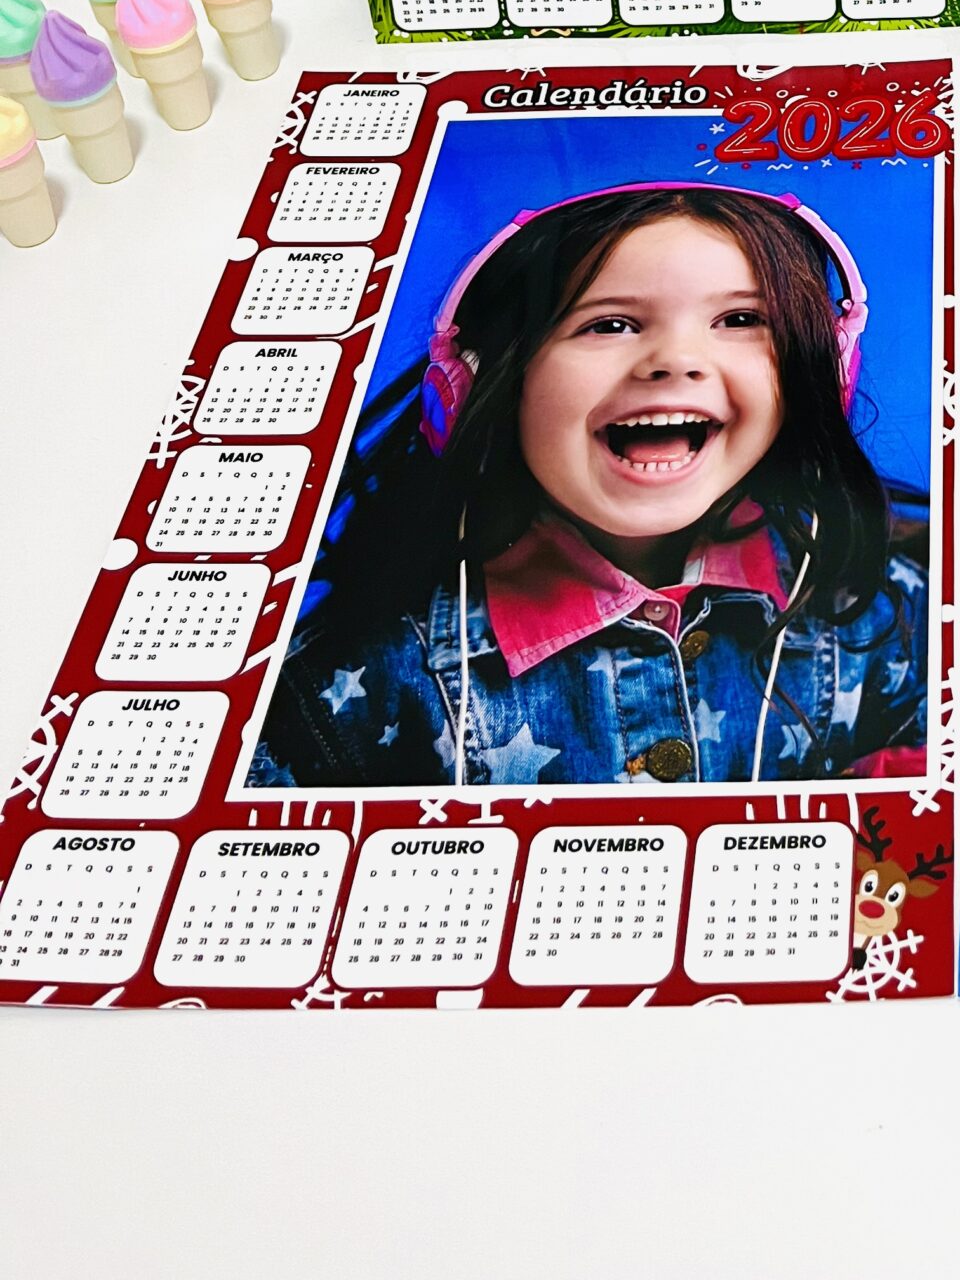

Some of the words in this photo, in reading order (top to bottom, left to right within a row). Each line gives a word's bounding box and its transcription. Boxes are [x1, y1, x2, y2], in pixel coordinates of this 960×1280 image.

[342, 89, 400, 98] JANEIRO
[483, 78, 709, 110] Calendário
[715, 91, 951, 162] 2026
[305, 166, 381, 176] FEVEREIRO
[287, 252, 344, 265] MARÇO
[254, 347, 298, 358] ABRIL
[218, 451, 264, 463] MAIO
[167, 570, 228, 582] JUNHO
[121, 698, 181, 712] JULHO
[51, 836, 136, 852] AGOSTO
[217, 841, 321, 857] SETEMBRO
[390, 839, 485, 856] OUTUBRO
[552, 837, 665, 854] NOVEMBRO
[723, 834, 827, 851] DEZEMBRO
